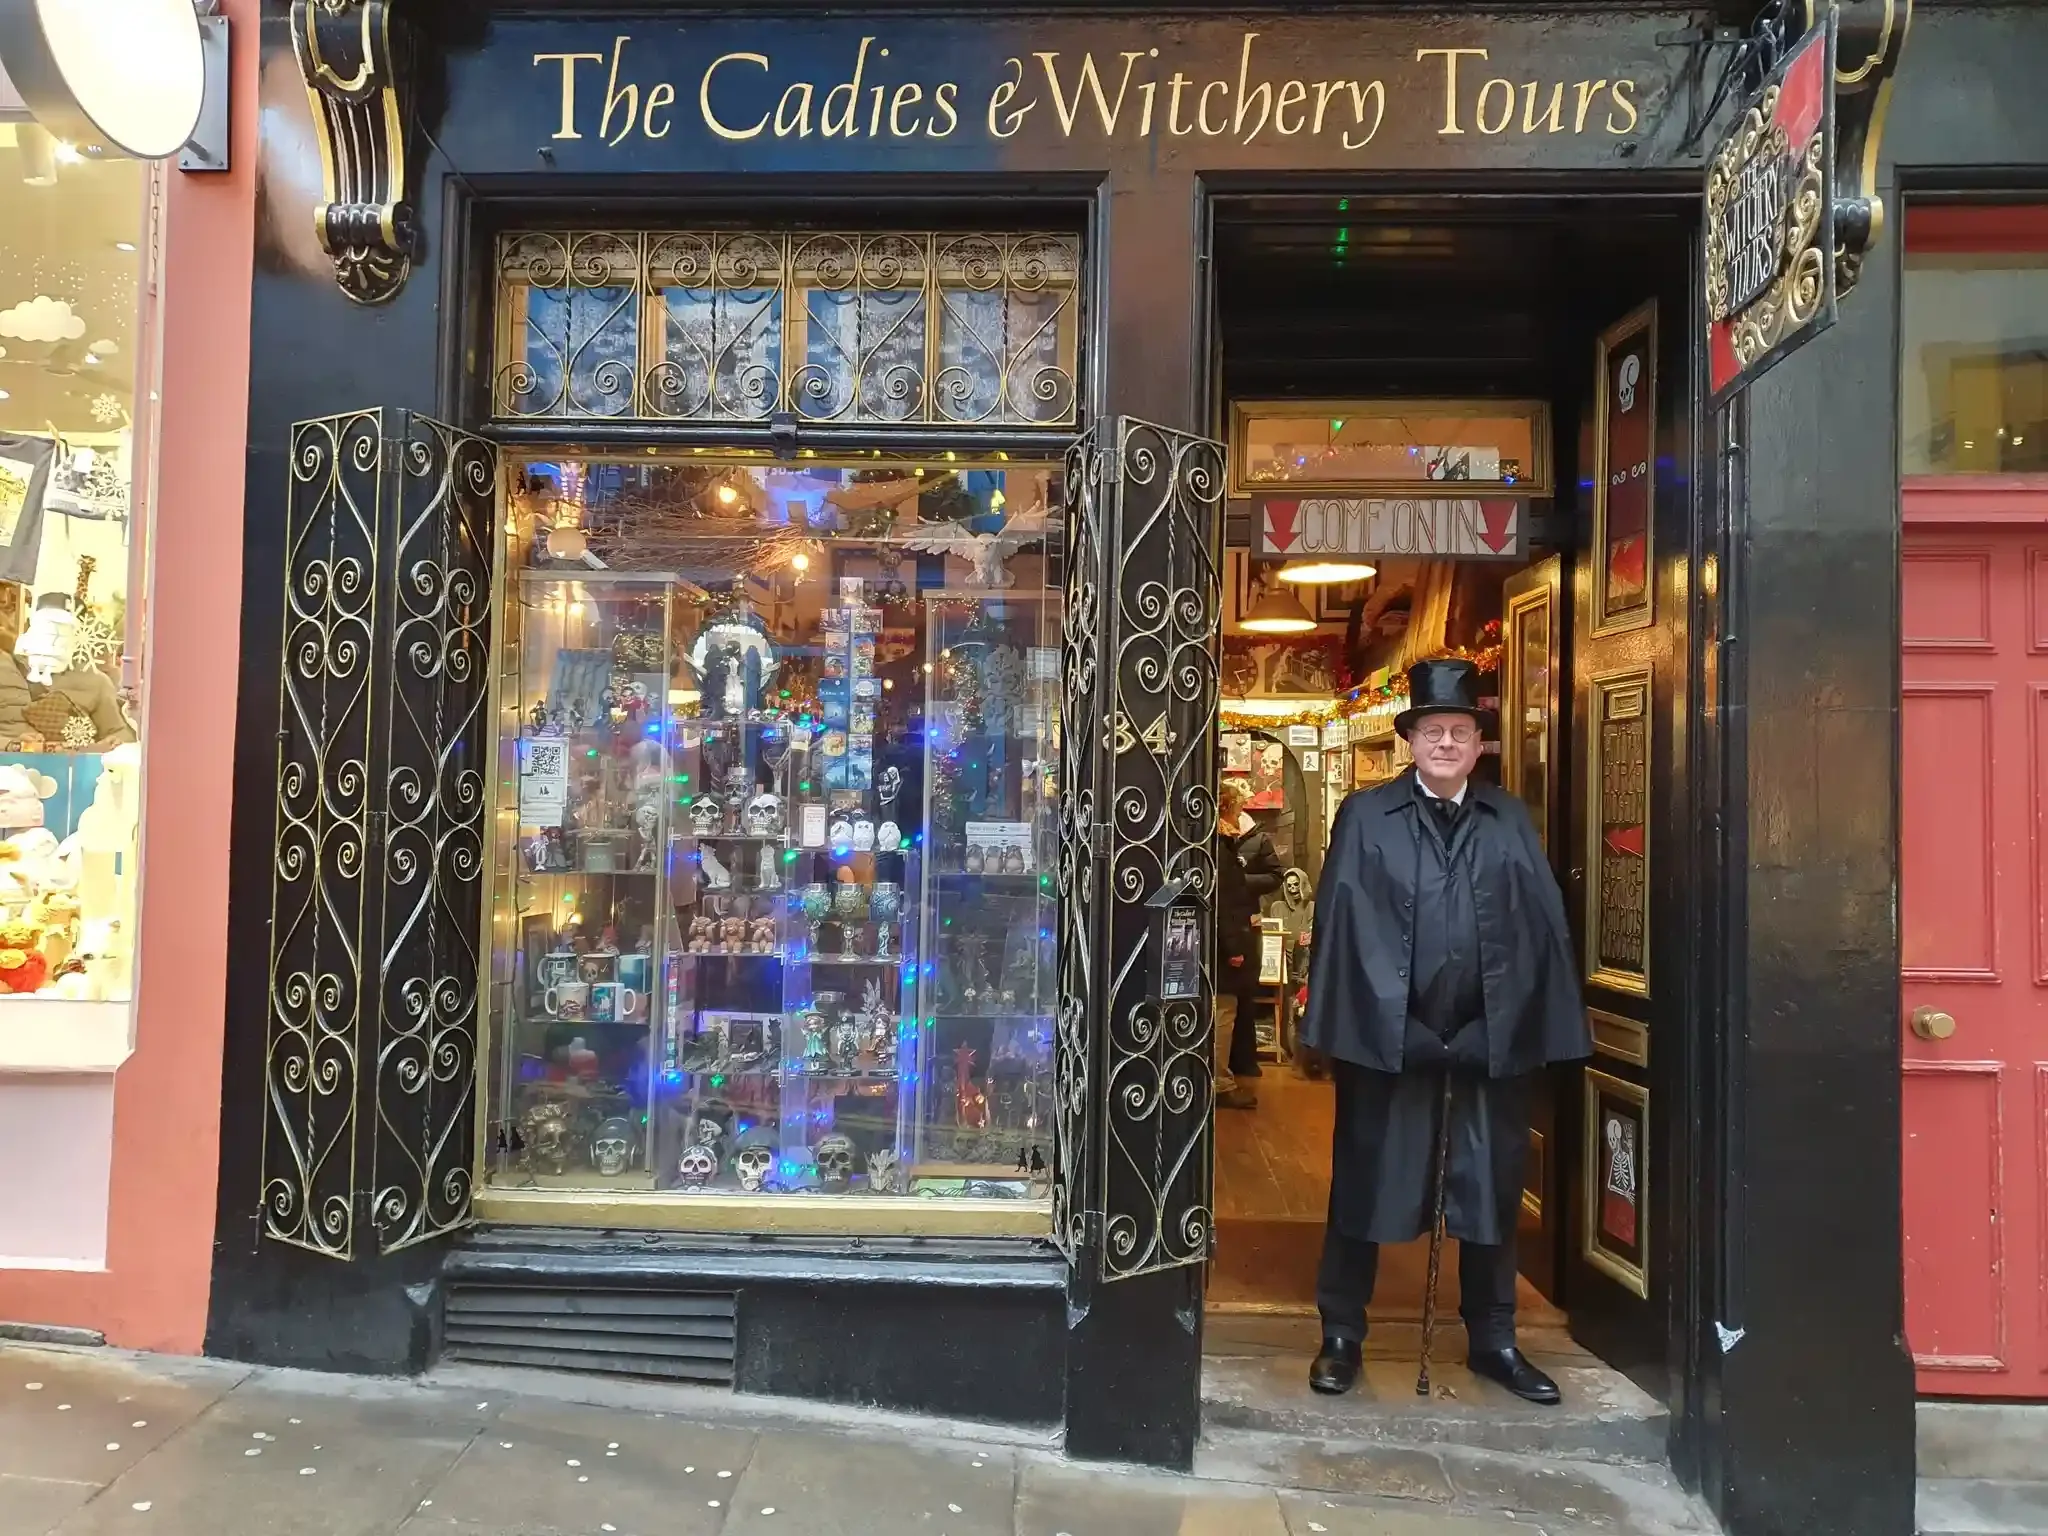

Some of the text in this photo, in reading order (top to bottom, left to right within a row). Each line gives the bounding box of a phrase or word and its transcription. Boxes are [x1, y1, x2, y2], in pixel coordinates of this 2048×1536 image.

[533, 33, 1639, 150] The Cadies & Witchery Tours
[1740, 157, 1761, 195] THE
[1731, 226, 1773, 308] TOURS
[1300, 499, 1479, 554] COME ON IN
[1102, 710, 1177, 756] 84
